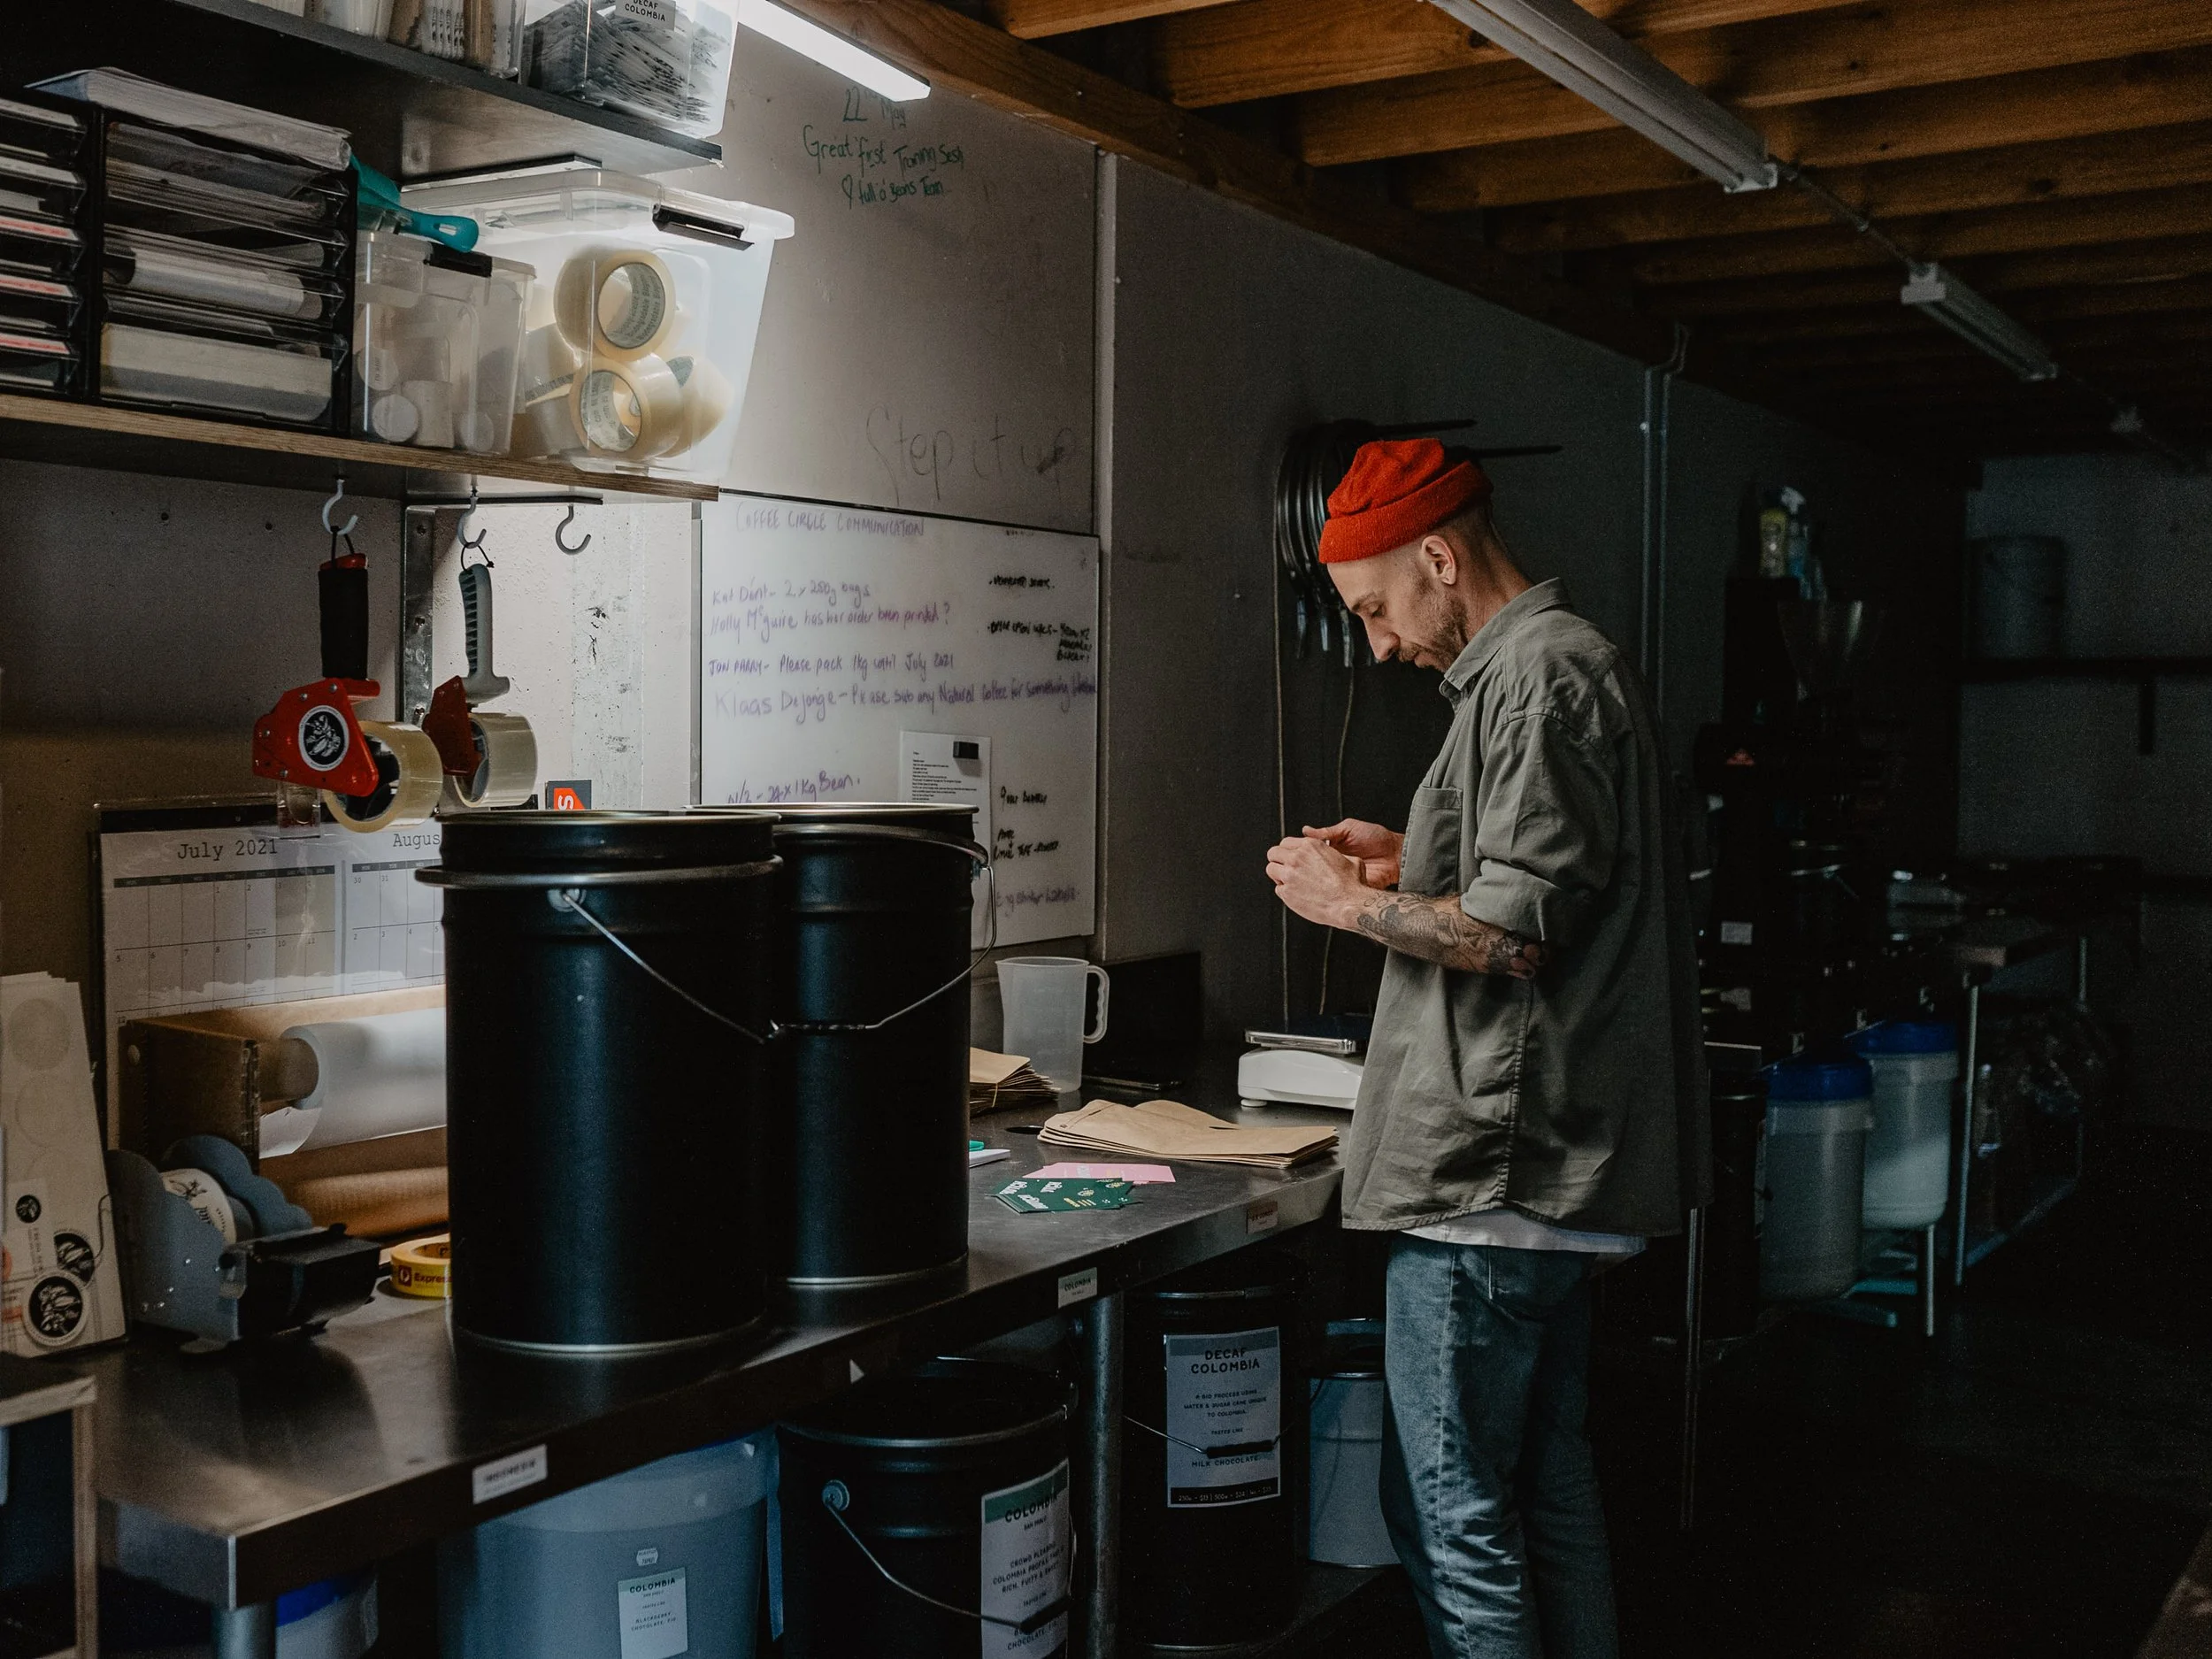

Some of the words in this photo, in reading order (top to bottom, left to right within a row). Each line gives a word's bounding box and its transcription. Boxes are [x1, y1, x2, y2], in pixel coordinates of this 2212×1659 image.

[625, 4, 665, 21] COLOMBIA
[803, 124, 854, 174] Great
[866, 401, 954, 506] Step
[787, 509, 826, 532] CIRCLE
[836, 512, 925, 537] COMMUNICATION
[715, 690, 772, 719] Klaas
[177, 841, 224, 861] July
[235, 838, 278, 856] 2021
[393, 833, 441, 849] Augus
[1204, 1348, 1247, 1361] DECAF
[1191, 1358, 1260, 1374] COLOMBIA
[1004, 1493, 1057, 1523] COLOMBIA
[1010, 1555, 1032, 1569] CROWD
[629, 1578, 676, 1594] COLOMBIA
[993, 1568, 1026, 1586] COLOMBIA
